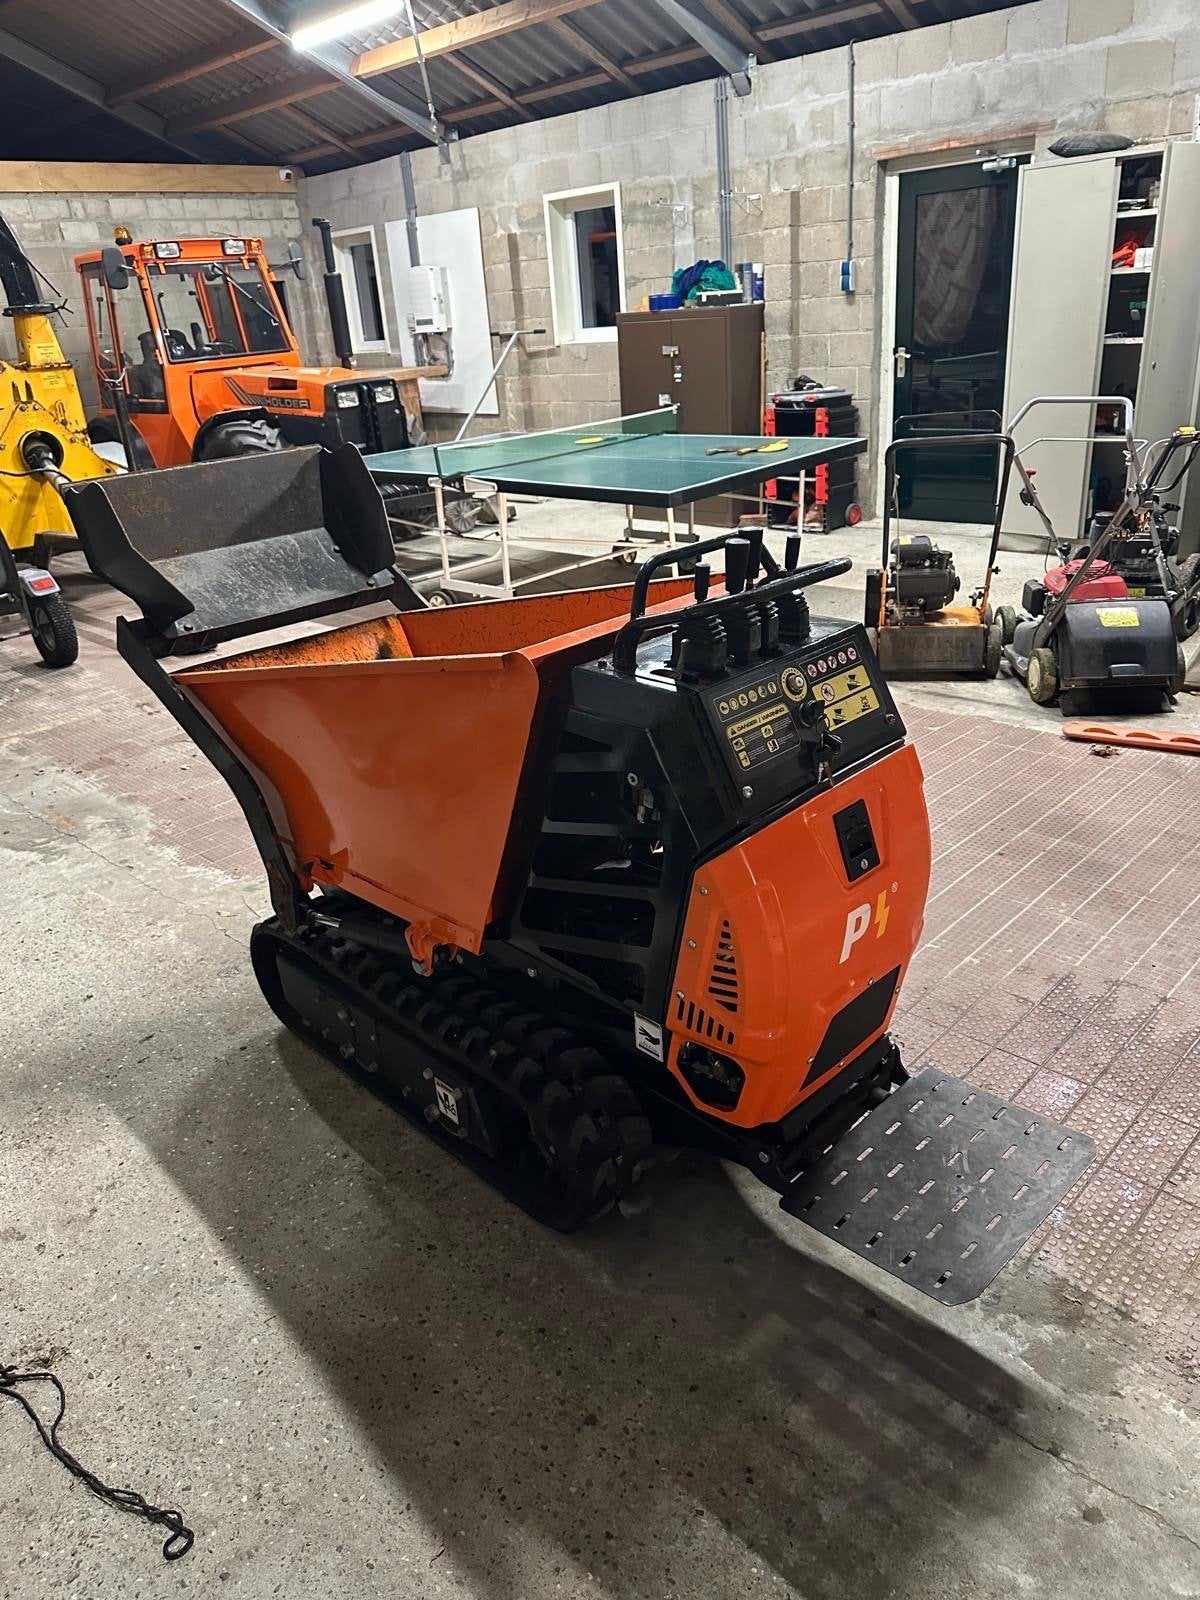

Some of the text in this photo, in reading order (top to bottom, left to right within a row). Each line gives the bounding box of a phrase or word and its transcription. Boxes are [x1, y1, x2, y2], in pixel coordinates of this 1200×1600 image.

[265, 396, 309, 408] HOLDER
[736, 718, 758, 732] DANGER
[760, 706, 785, 720] WARNING
